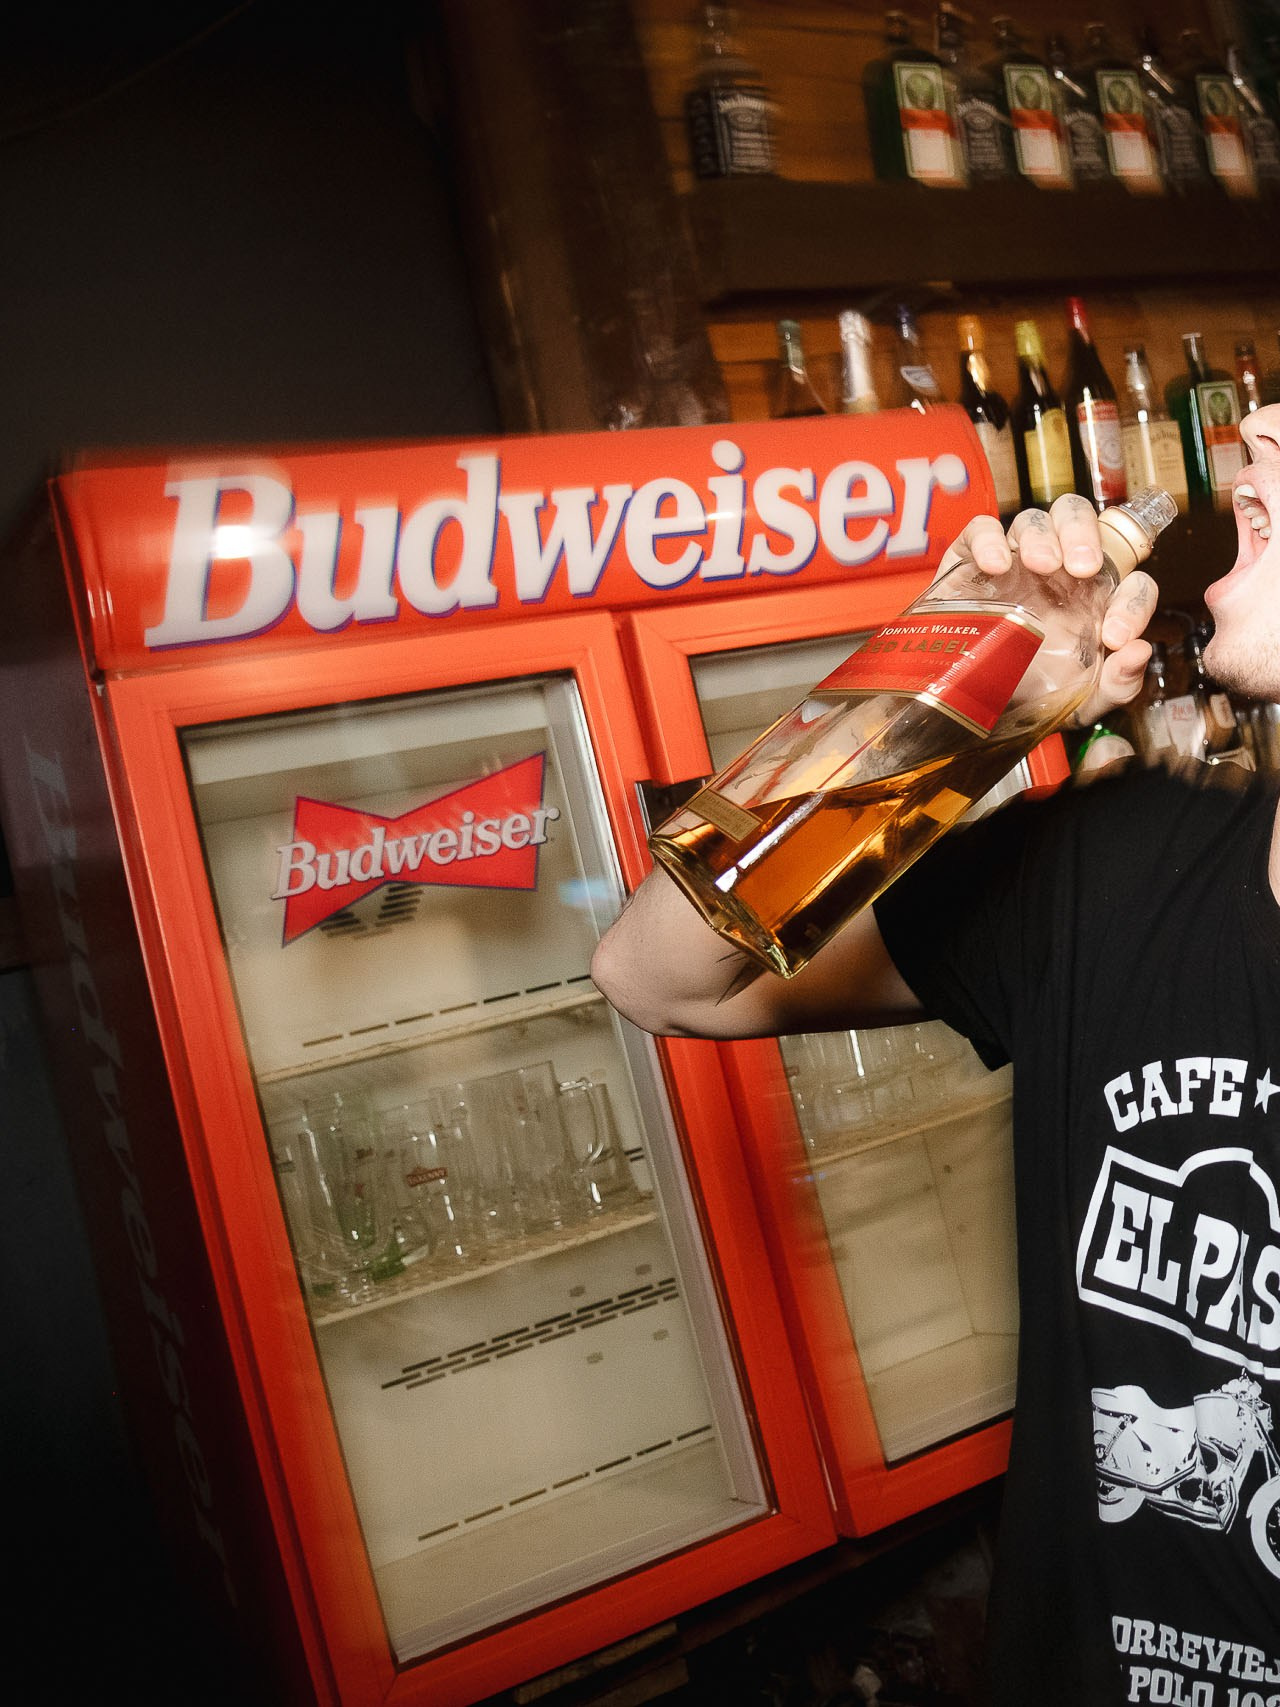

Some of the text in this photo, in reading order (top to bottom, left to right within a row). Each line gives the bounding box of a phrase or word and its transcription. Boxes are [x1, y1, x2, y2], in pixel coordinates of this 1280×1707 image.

[144, 440, 969, 652] Budweiser
[877, 626, 927, 638] JOHNNIE
[270, 807, 560, 900] Budweiser
[1103, 1057, 1248, 1133] CAFE
[1094, 1180, 1183, 1303] EL
[1128, 1665, 1215, 1707] POLO
